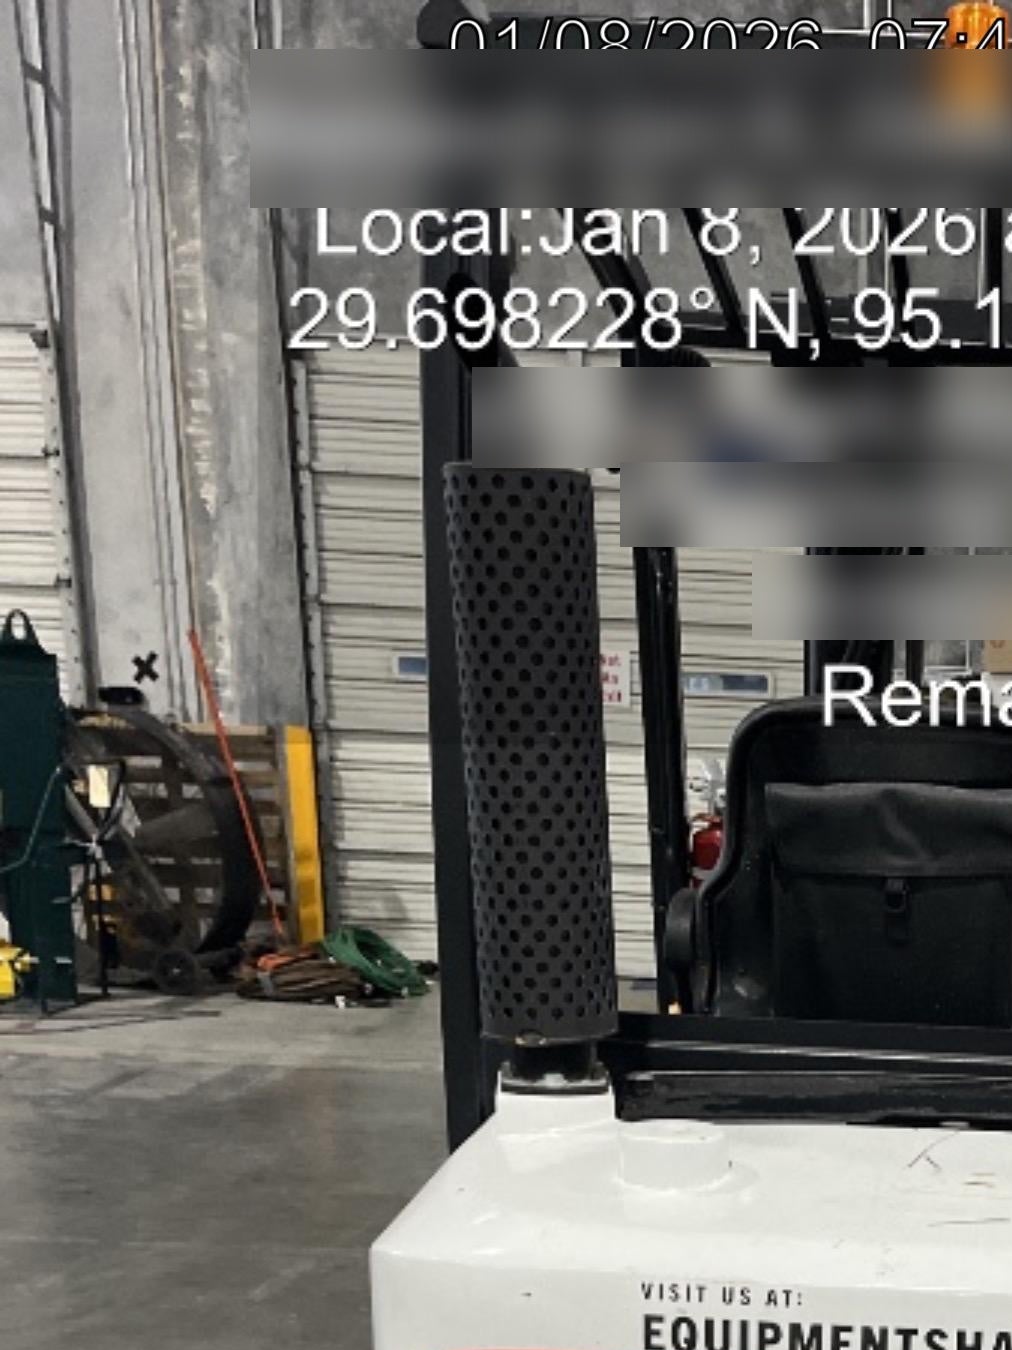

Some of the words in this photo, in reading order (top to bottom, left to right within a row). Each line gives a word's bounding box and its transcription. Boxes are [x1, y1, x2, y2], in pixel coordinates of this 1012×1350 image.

[640, 1283, 707, 1303] VISIT
[721, 1286, 751, 1306] US
[764, 1289, 803, 1308] AT:
